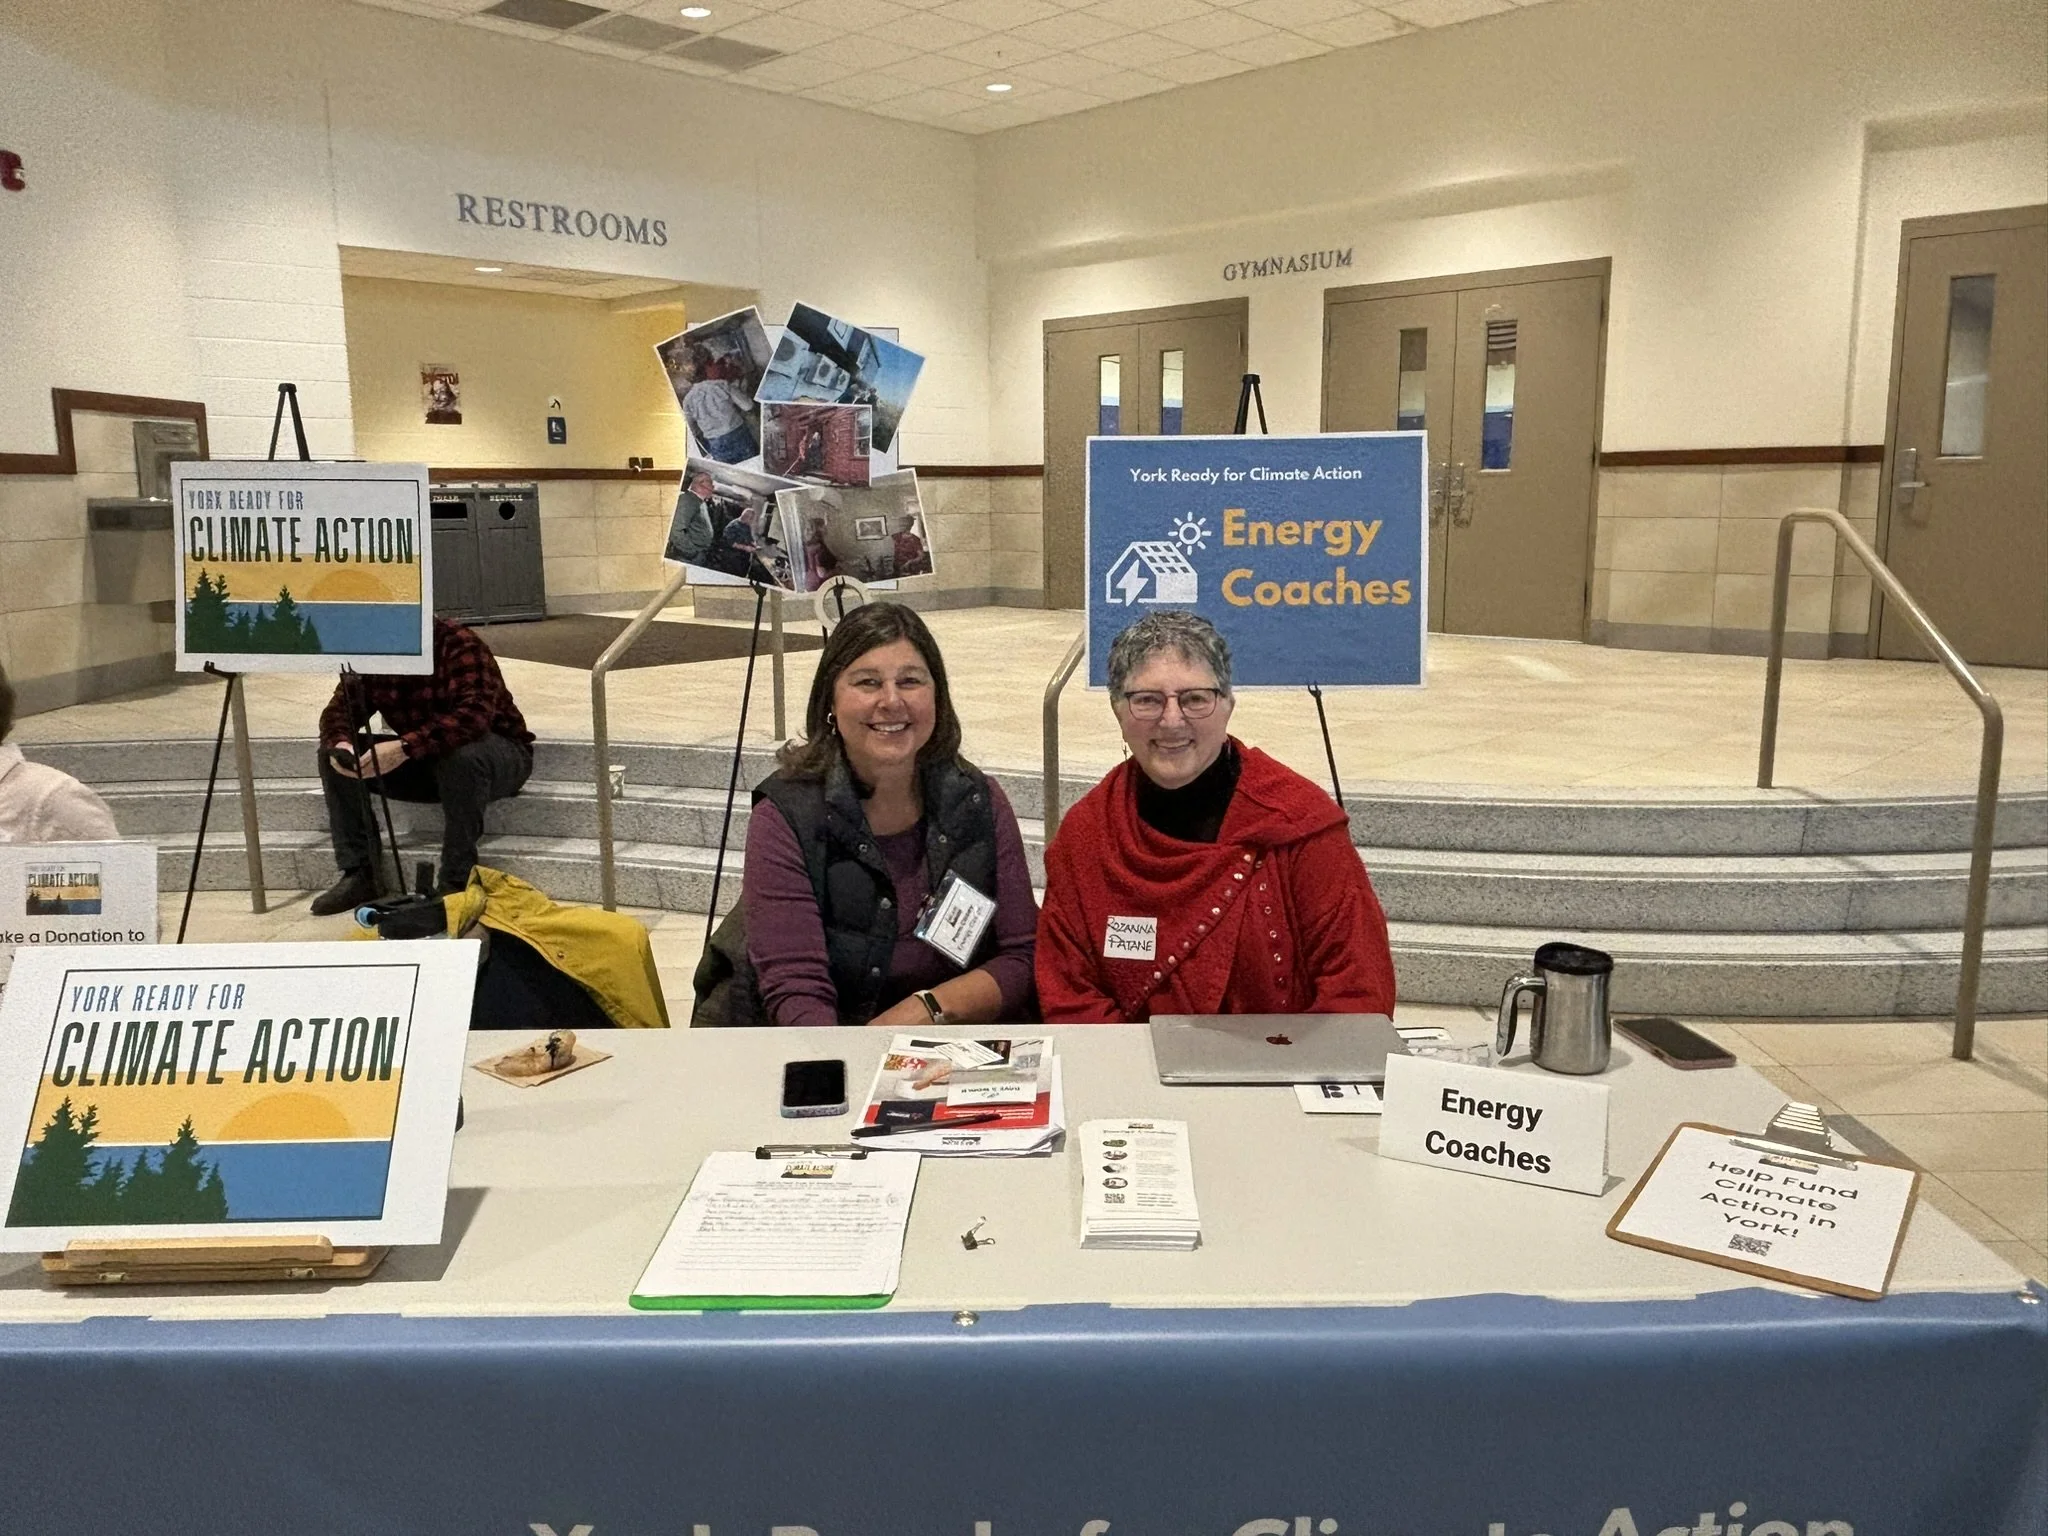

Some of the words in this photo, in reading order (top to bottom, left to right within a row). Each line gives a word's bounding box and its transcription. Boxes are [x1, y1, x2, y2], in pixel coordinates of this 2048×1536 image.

[456, 192, 668, 248] RESTROOMS
[1223, 247, 1353, 281] GYMNASIUM
[1130, 468, 1167, 482] York
[1171, 467, 1218, 485] Ready
[1223, 467, 1246, 482] for
[1250, 467, 1309, 481] Climate
[1312, 466, 1362, 480] Action
[189, 490, 222, 510] YORK
[229, 490, 271, 510] READY
[279, 490, 304, 510] FOR
[190, 516, 303, 563] CLIMATE
[315, 517, 413, 564] ACTION
[1222, 508, 1383, 556] Energy
[1221, 567, 1412, 607] Coaches
[29, 933, 40, 943] a
[45, 929, 123, 943] Donation
[128, 929, 145, 942] to
[1108, 934, 1153, 951] PATANE
[71, 985, 123, 1012] YORK
[132, 984, 198, 1011] READY
[207, 983, 246, 1010] FOR
[52, 1020, 235, 1087] CLIMATE
[243, 1016, 400, 1084] ACTION
[1441, 1088, 1543, 1132] Energy
[1425, 1130, 1551, 1174] Coaches
[1707, 1161, 1774, 1182] Help
[1782, 1176, 1859, 1200] Fund
[1715, 1179, 1837, 1211] Climate
[1700, 1192, 1798, 1221] Action
[1809, 1214, 1836, 1229] in
[1724, 1212, 1799, 1238] York!
